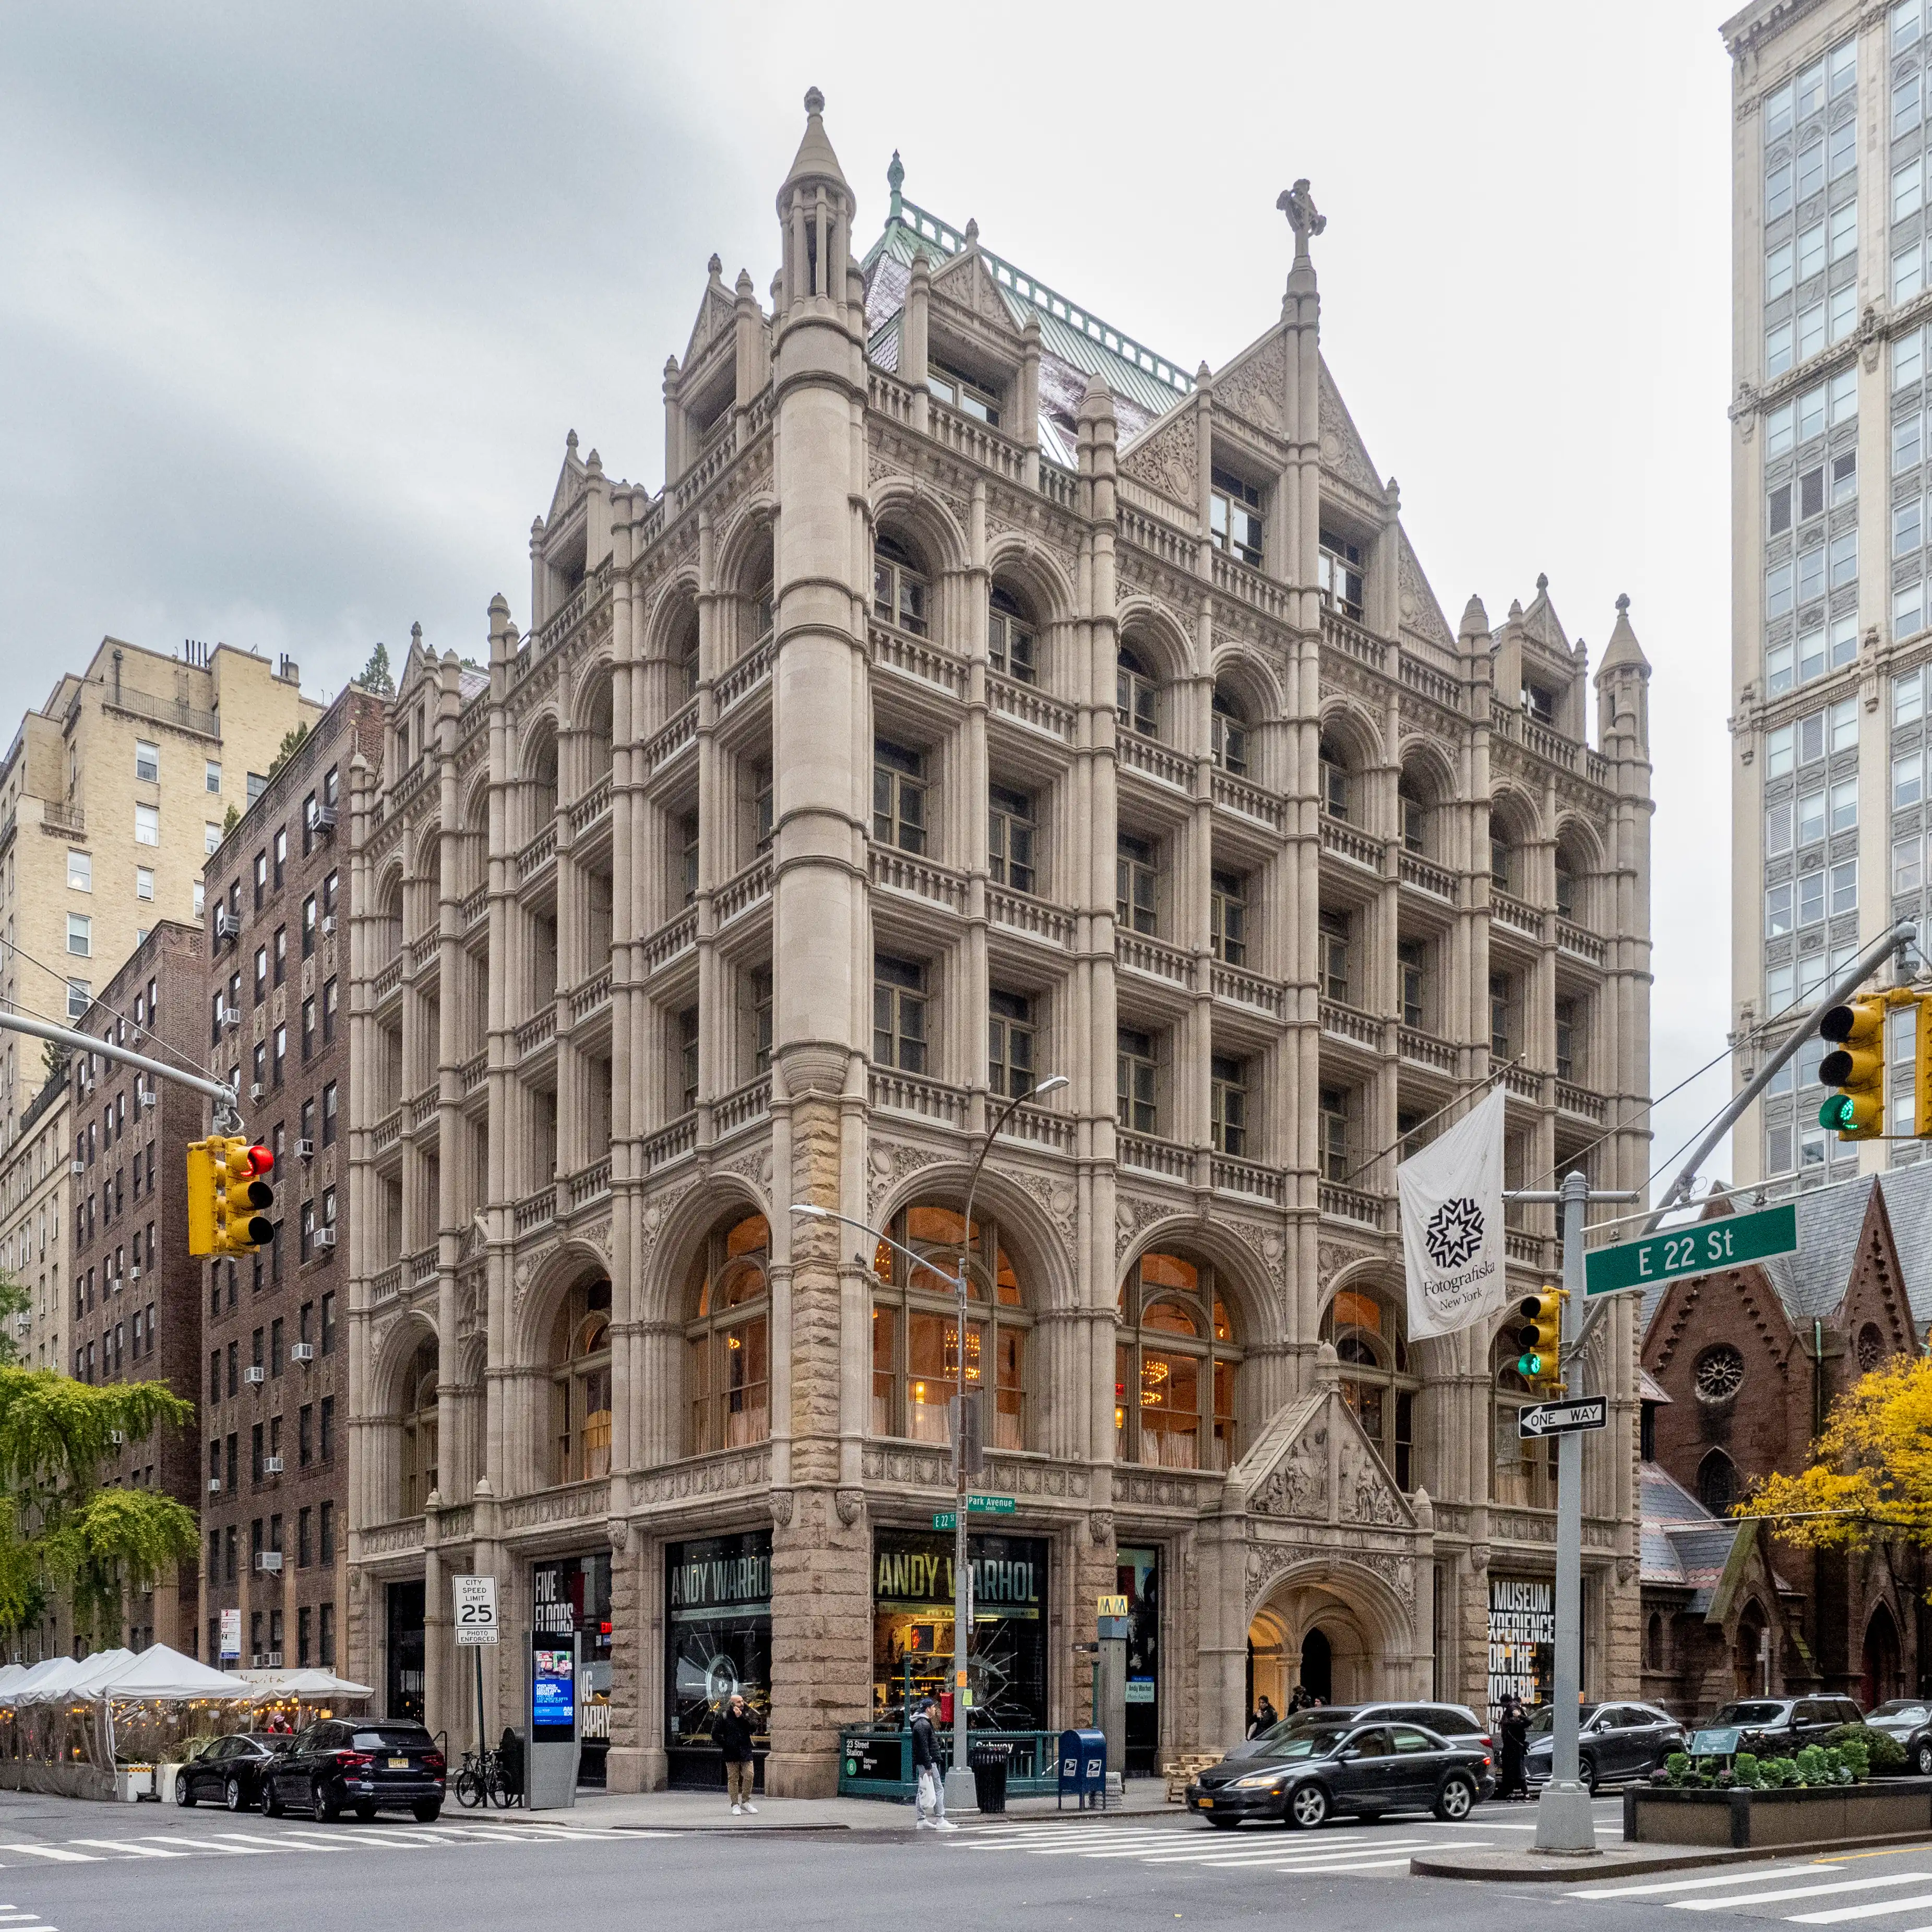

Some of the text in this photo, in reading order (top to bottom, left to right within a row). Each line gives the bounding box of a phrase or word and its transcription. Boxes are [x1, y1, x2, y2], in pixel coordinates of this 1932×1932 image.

[1639, 1229, 1733, 1276] E 22 St
[1424, 1261, 1495, 1297] Fotografiska
[1440, 1287, 1483, 1311] New York
[1531, 1406, 1599, 1427] ONE WAY
[969, 1496, 1012, 1507] Park Avenue
[935, 1516, 939, 1528] E
[941, 1514, 948, 1527] 22
[535, 1570, 556, 1603] FIVE
[671, 1563, 709, 1605] ANDY
[877, 1553, 939, 1597] ANDY
[1494, 1581, 1550, 1612] MUSEUM
[461, 1604, 492, 1623] 25
[535, 1603, 574, 1631] FLOORS
[1509, 1644, 1533, 1674] THE
[581, 1705, 612, 1737] APHY
[846, 1748, 864, 1757] Station
[854, 1740, 869, 1749] Street
[976, 1742, 1013, 1754] Subway
